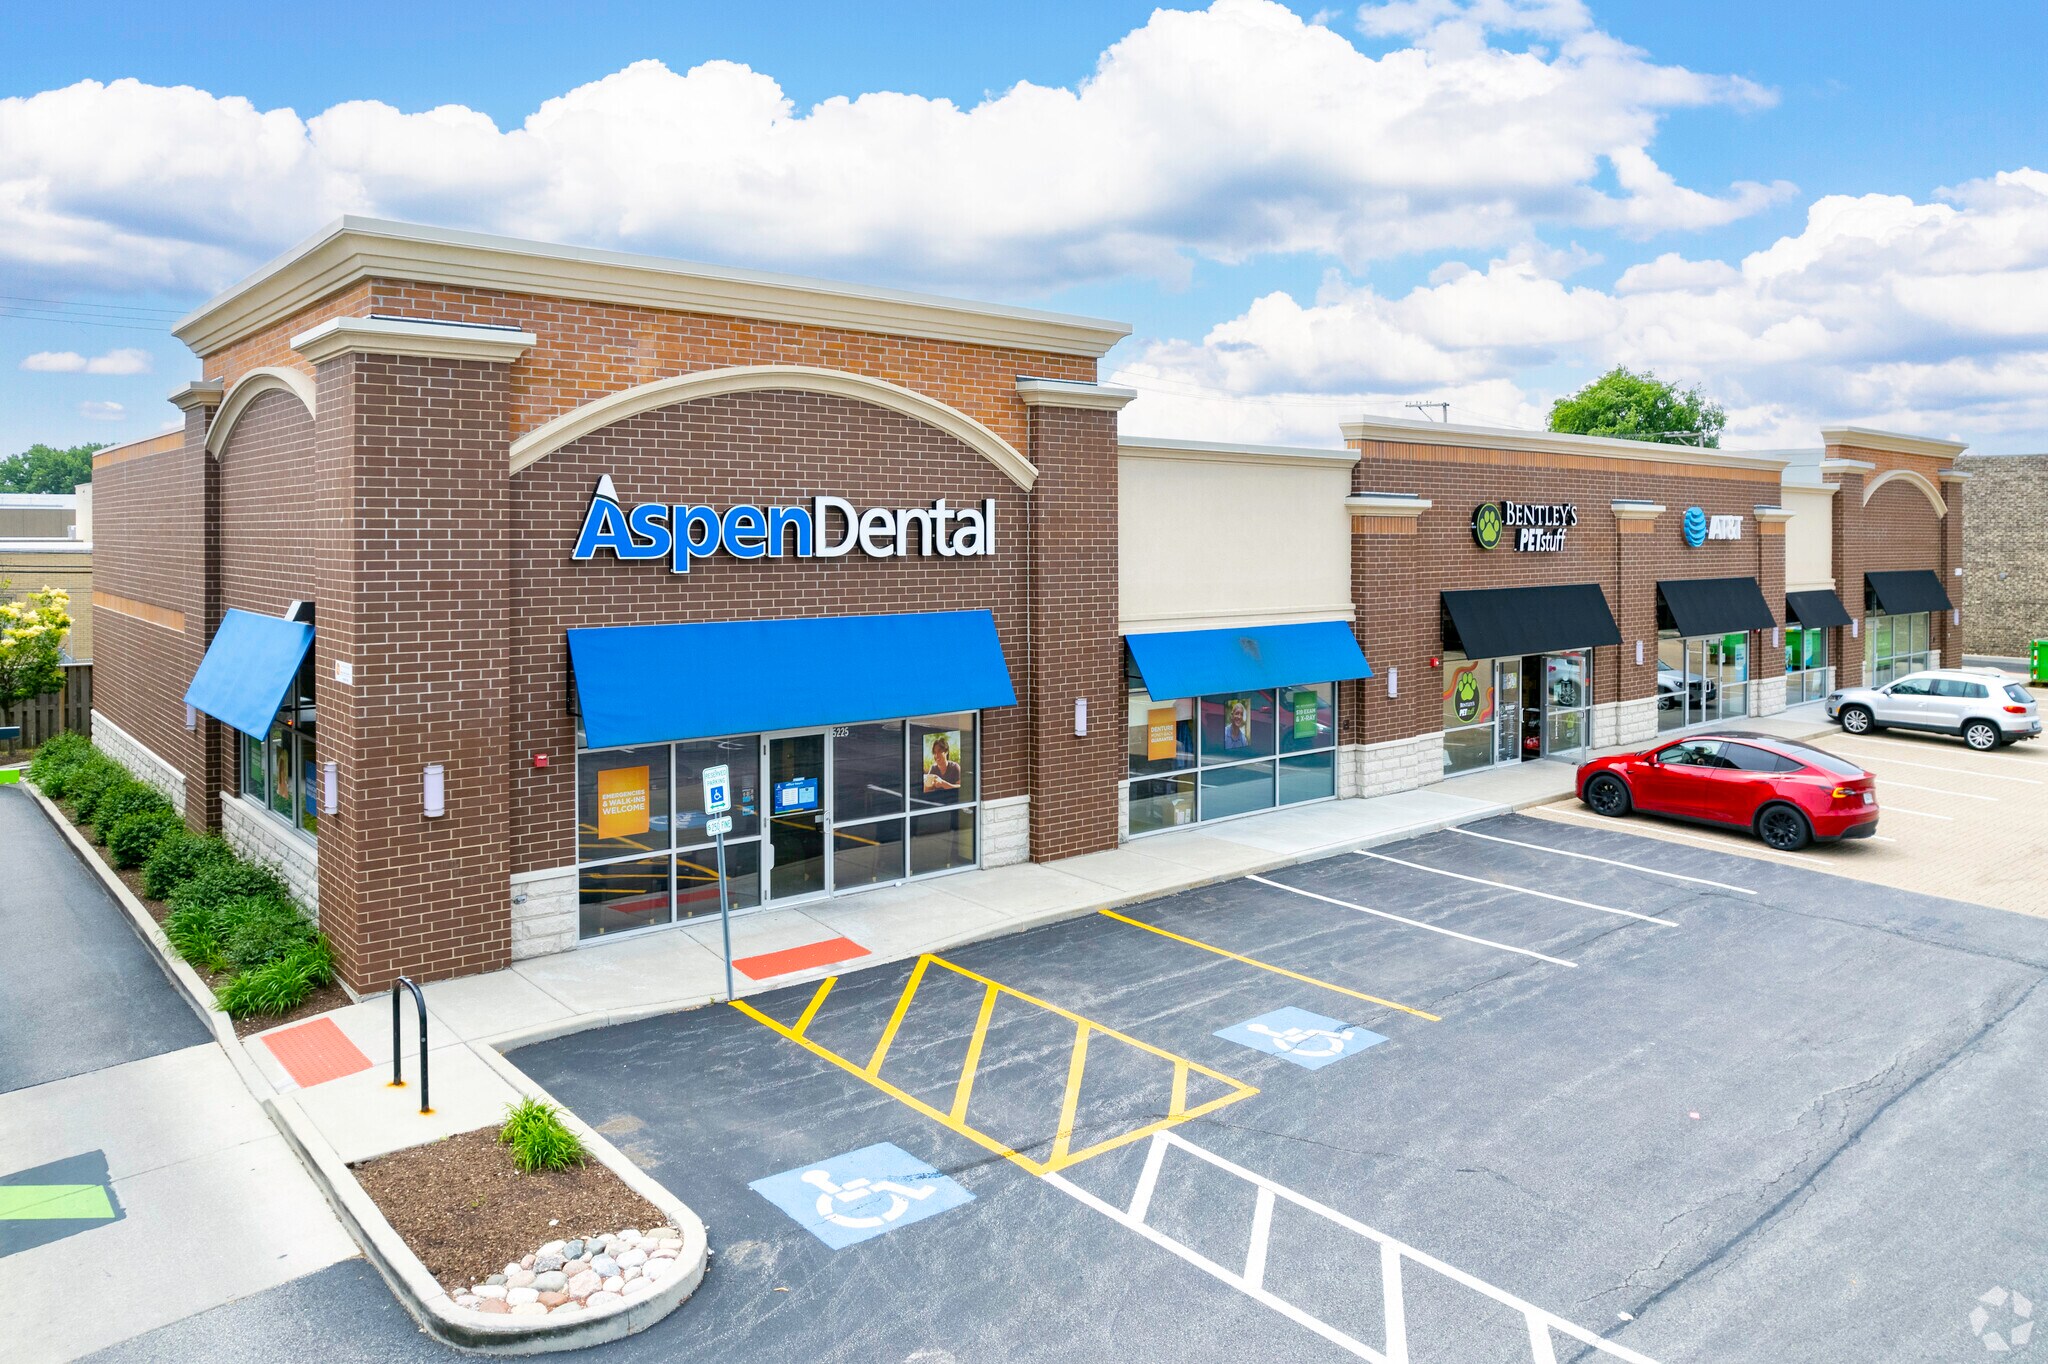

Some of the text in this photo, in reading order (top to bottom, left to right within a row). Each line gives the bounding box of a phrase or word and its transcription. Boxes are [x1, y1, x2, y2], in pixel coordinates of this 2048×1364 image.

[1505, 500, 1578, 526] BENTLEY'S
[1708, 514, 1744, 540] AT&T
[1300, 714, 1316, 722] X-RAY
[1150, 724, 1174, 733] DENTURE
[704, 770, 727, 779] RESERVED
[706, 777, 726, 786] PARKING
[602, 790, 645, 800] EMERGENCIES
[609, 795, 646, 806] WALK-INS
[602, 803, 645, 815] WELCOME
[721, 818, 731, 829] FINE
